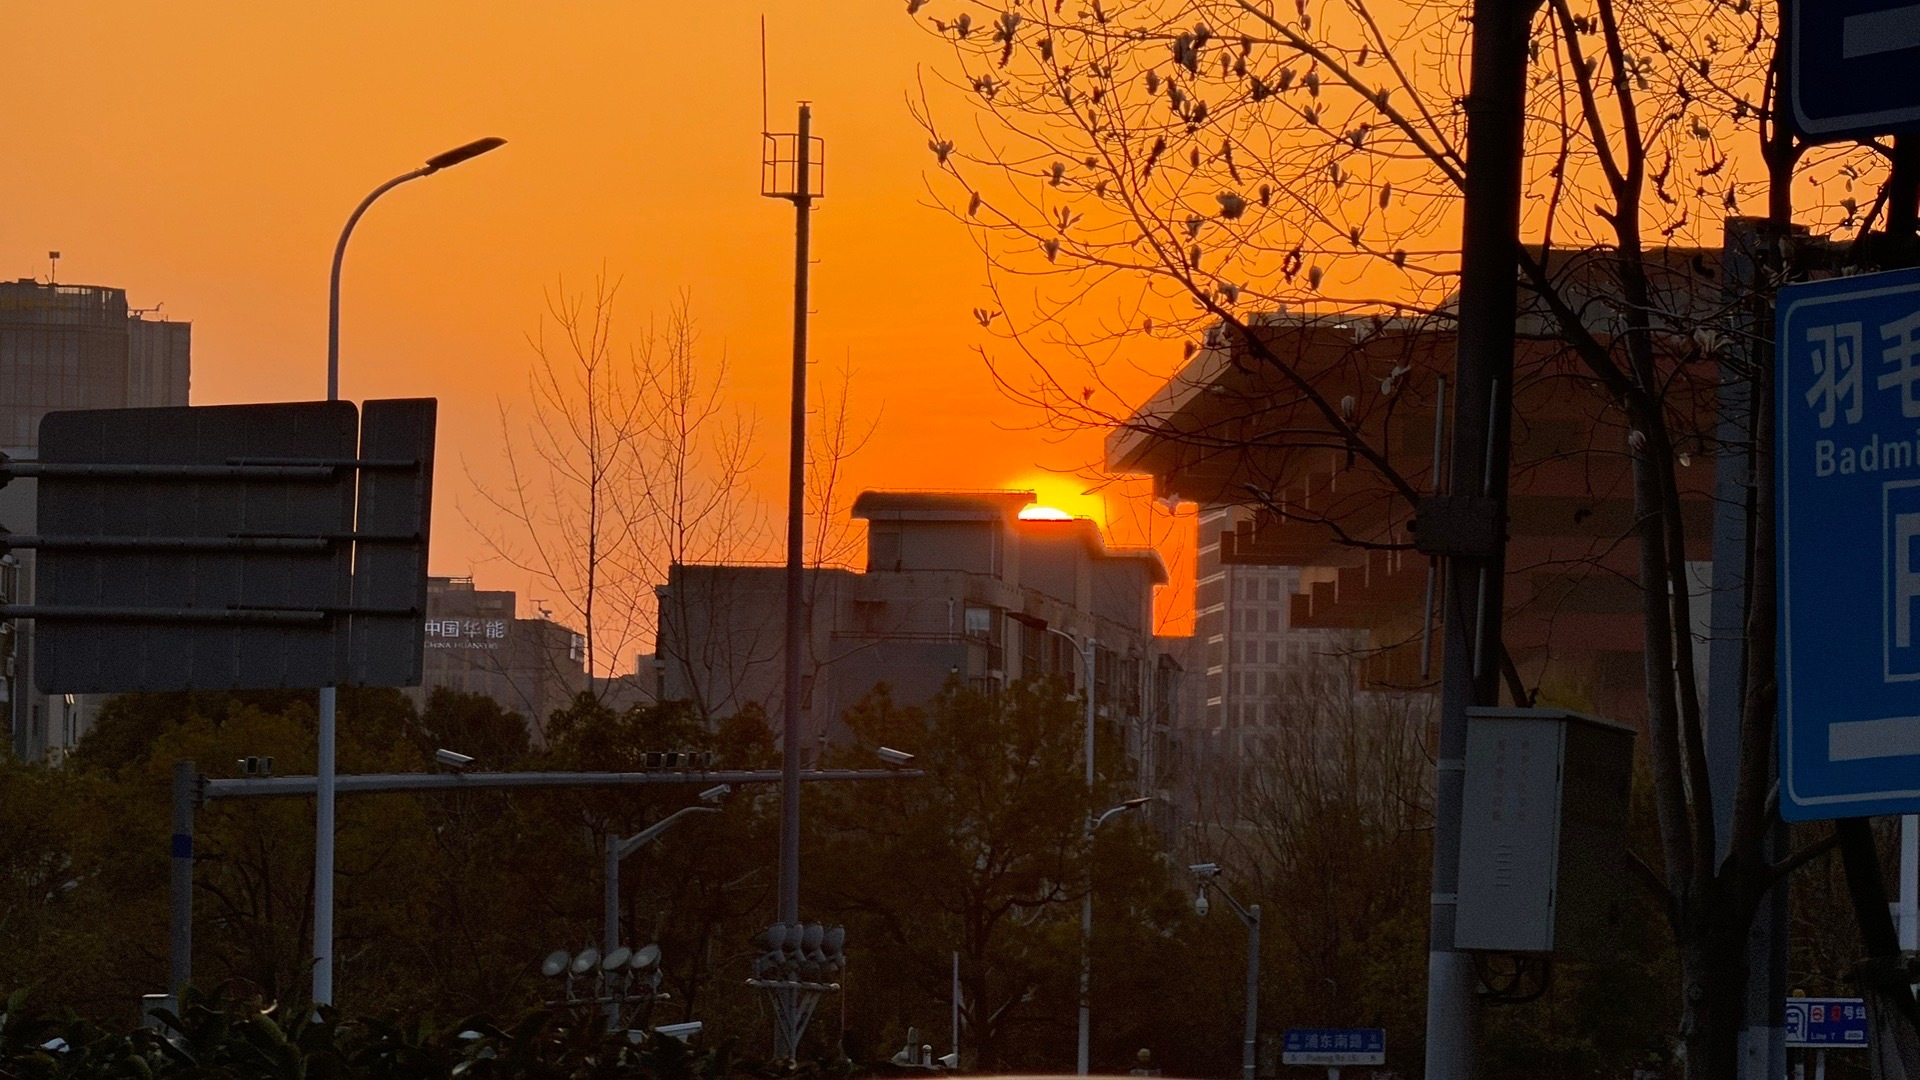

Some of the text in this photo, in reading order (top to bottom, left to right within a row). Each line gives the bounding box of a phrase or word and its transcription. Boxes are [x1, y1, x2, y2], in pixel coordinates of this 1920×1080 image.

[1805, 310, 1920, 428] 羽毛
[425, 620, 504, 638] 中国华能
[1305, 1034, 1362, 1049] 浦东南路
